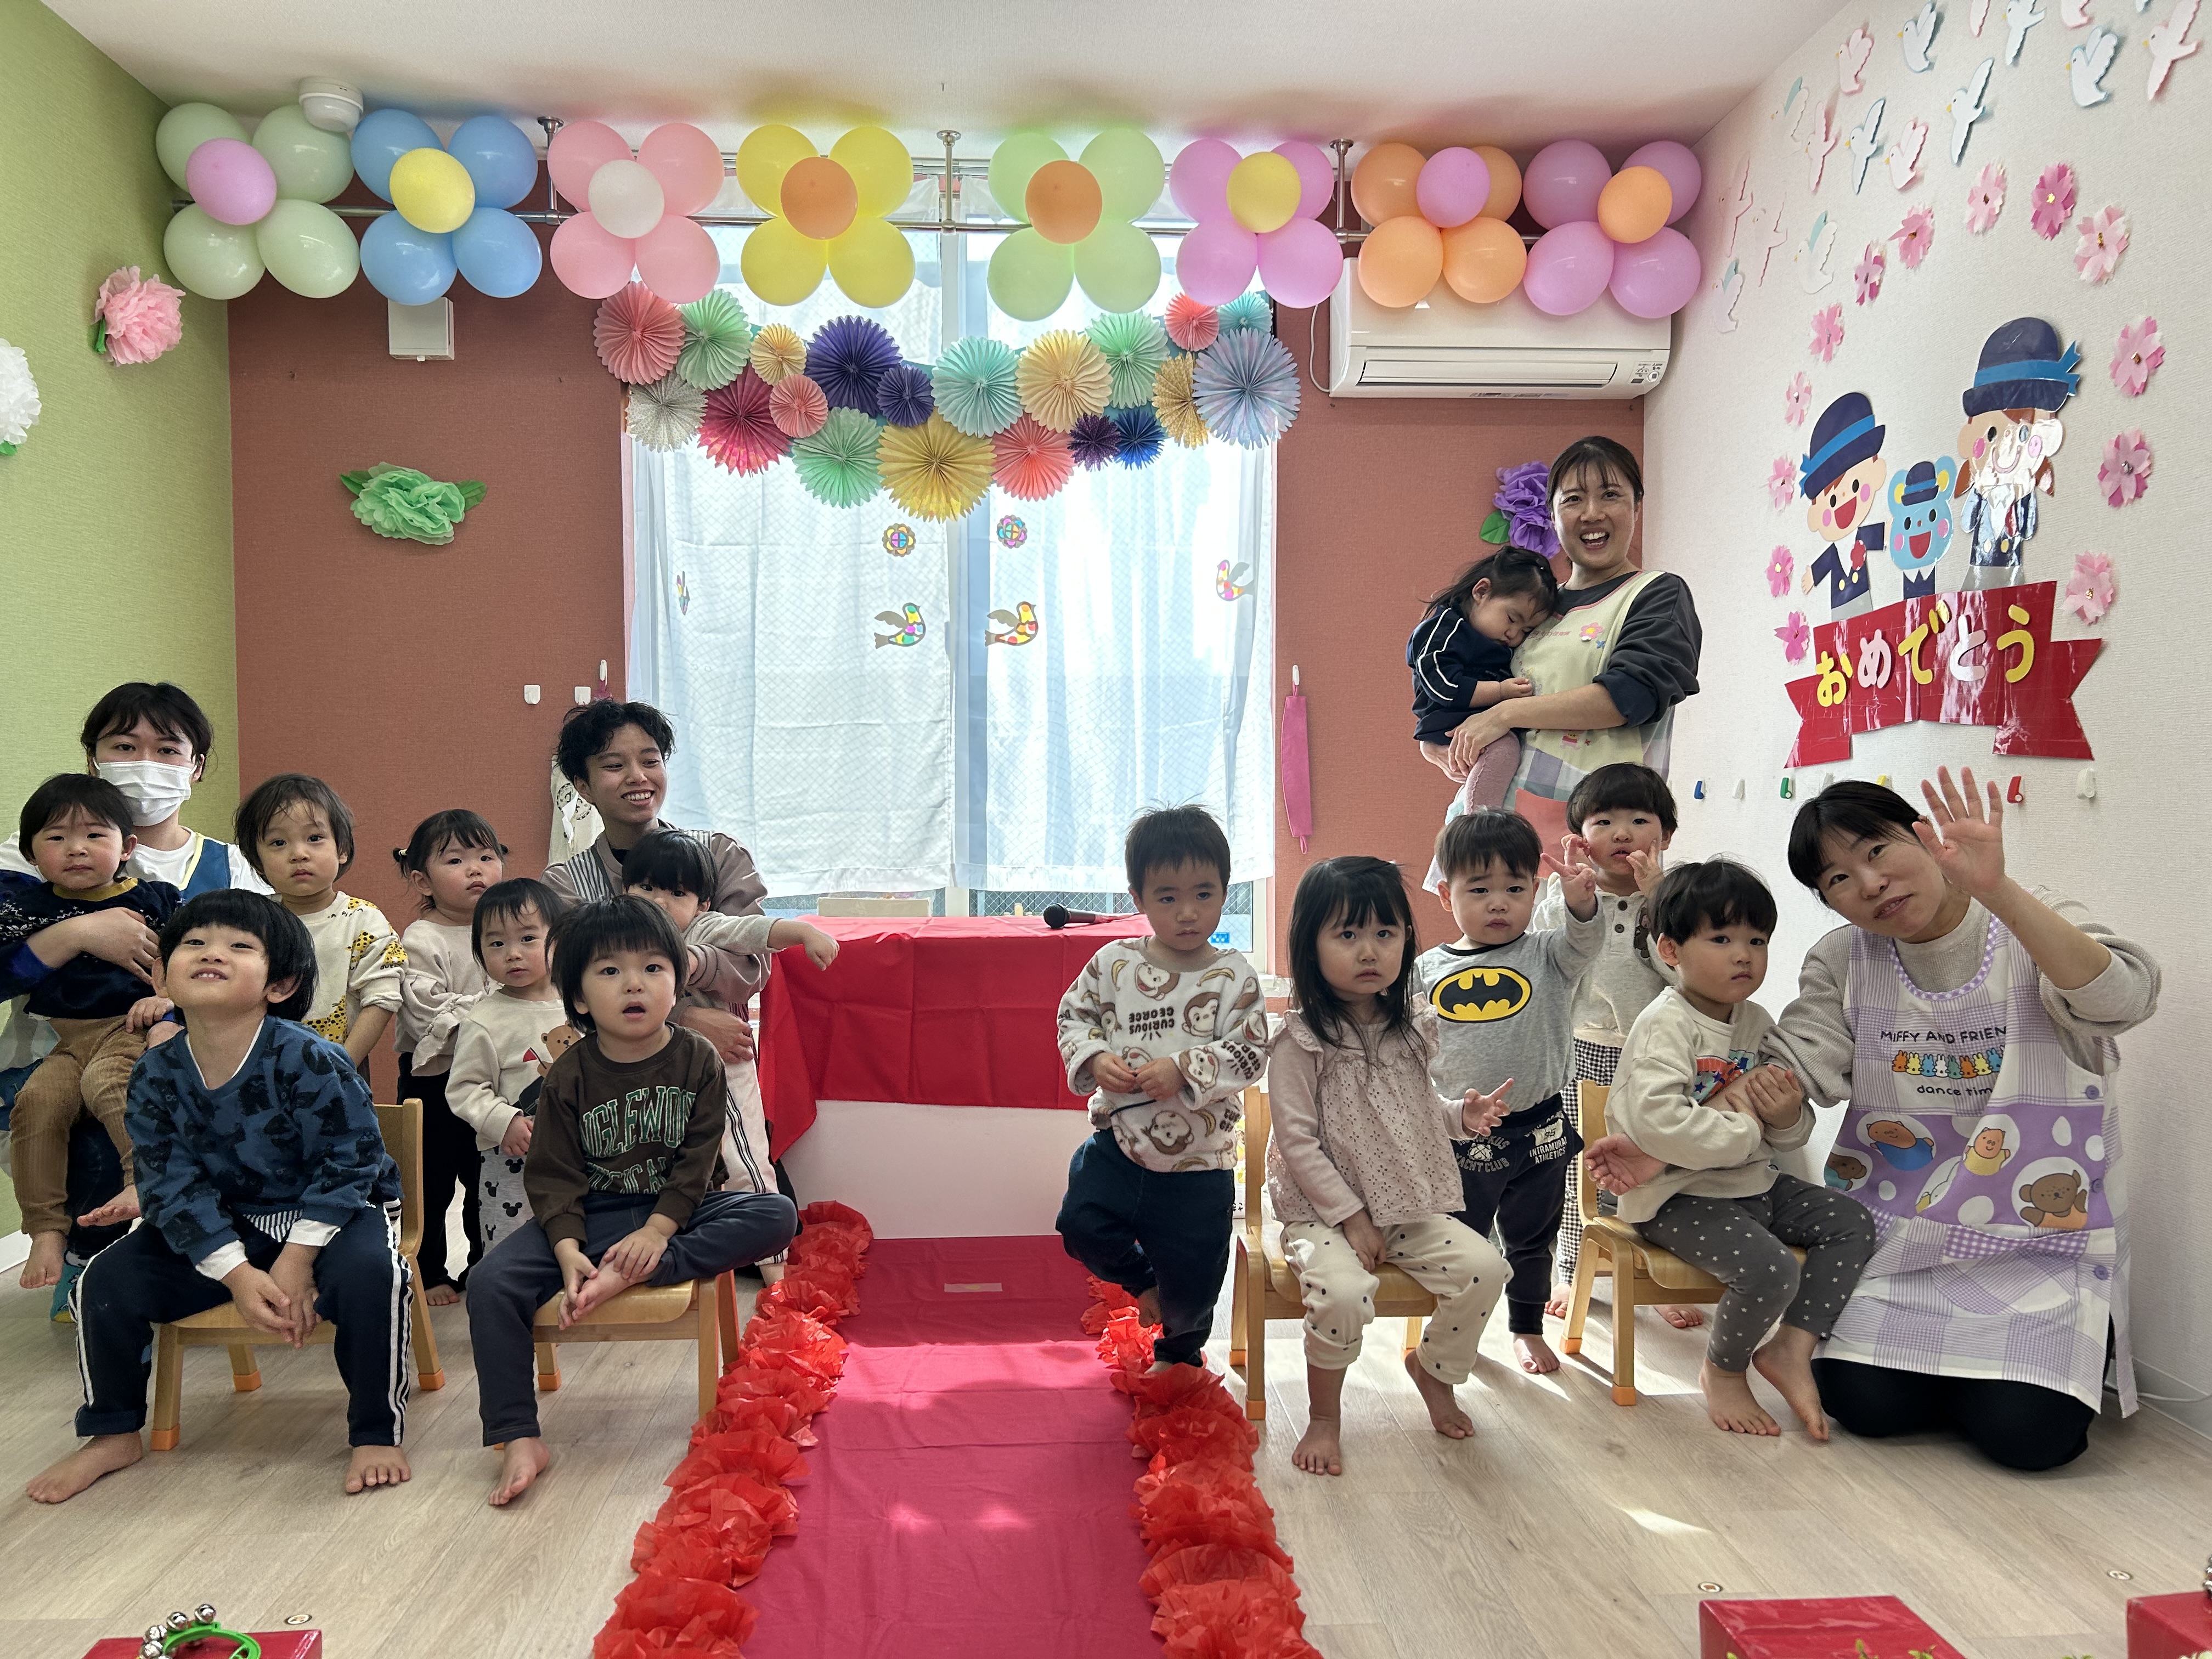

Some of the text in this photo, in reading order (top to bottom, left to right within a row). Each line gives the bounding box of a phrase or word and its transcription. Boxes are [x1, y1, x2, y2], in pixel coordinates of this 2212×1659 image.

[1815, 599, 2035, 707] おめでとう
[1128, 1006, 1175, 1023] GEORGE
[1129, 1018, 1175, 1035] CURIOUS
[1881, 1026, 2006, 1043] MIFFY AND FRIEN
[1235, 1042, 1261, 1071] GEOR
[1917, 1085, 1962, 1096] dance
[1455, 1153, 1510, 1172] YACHT CLUB
